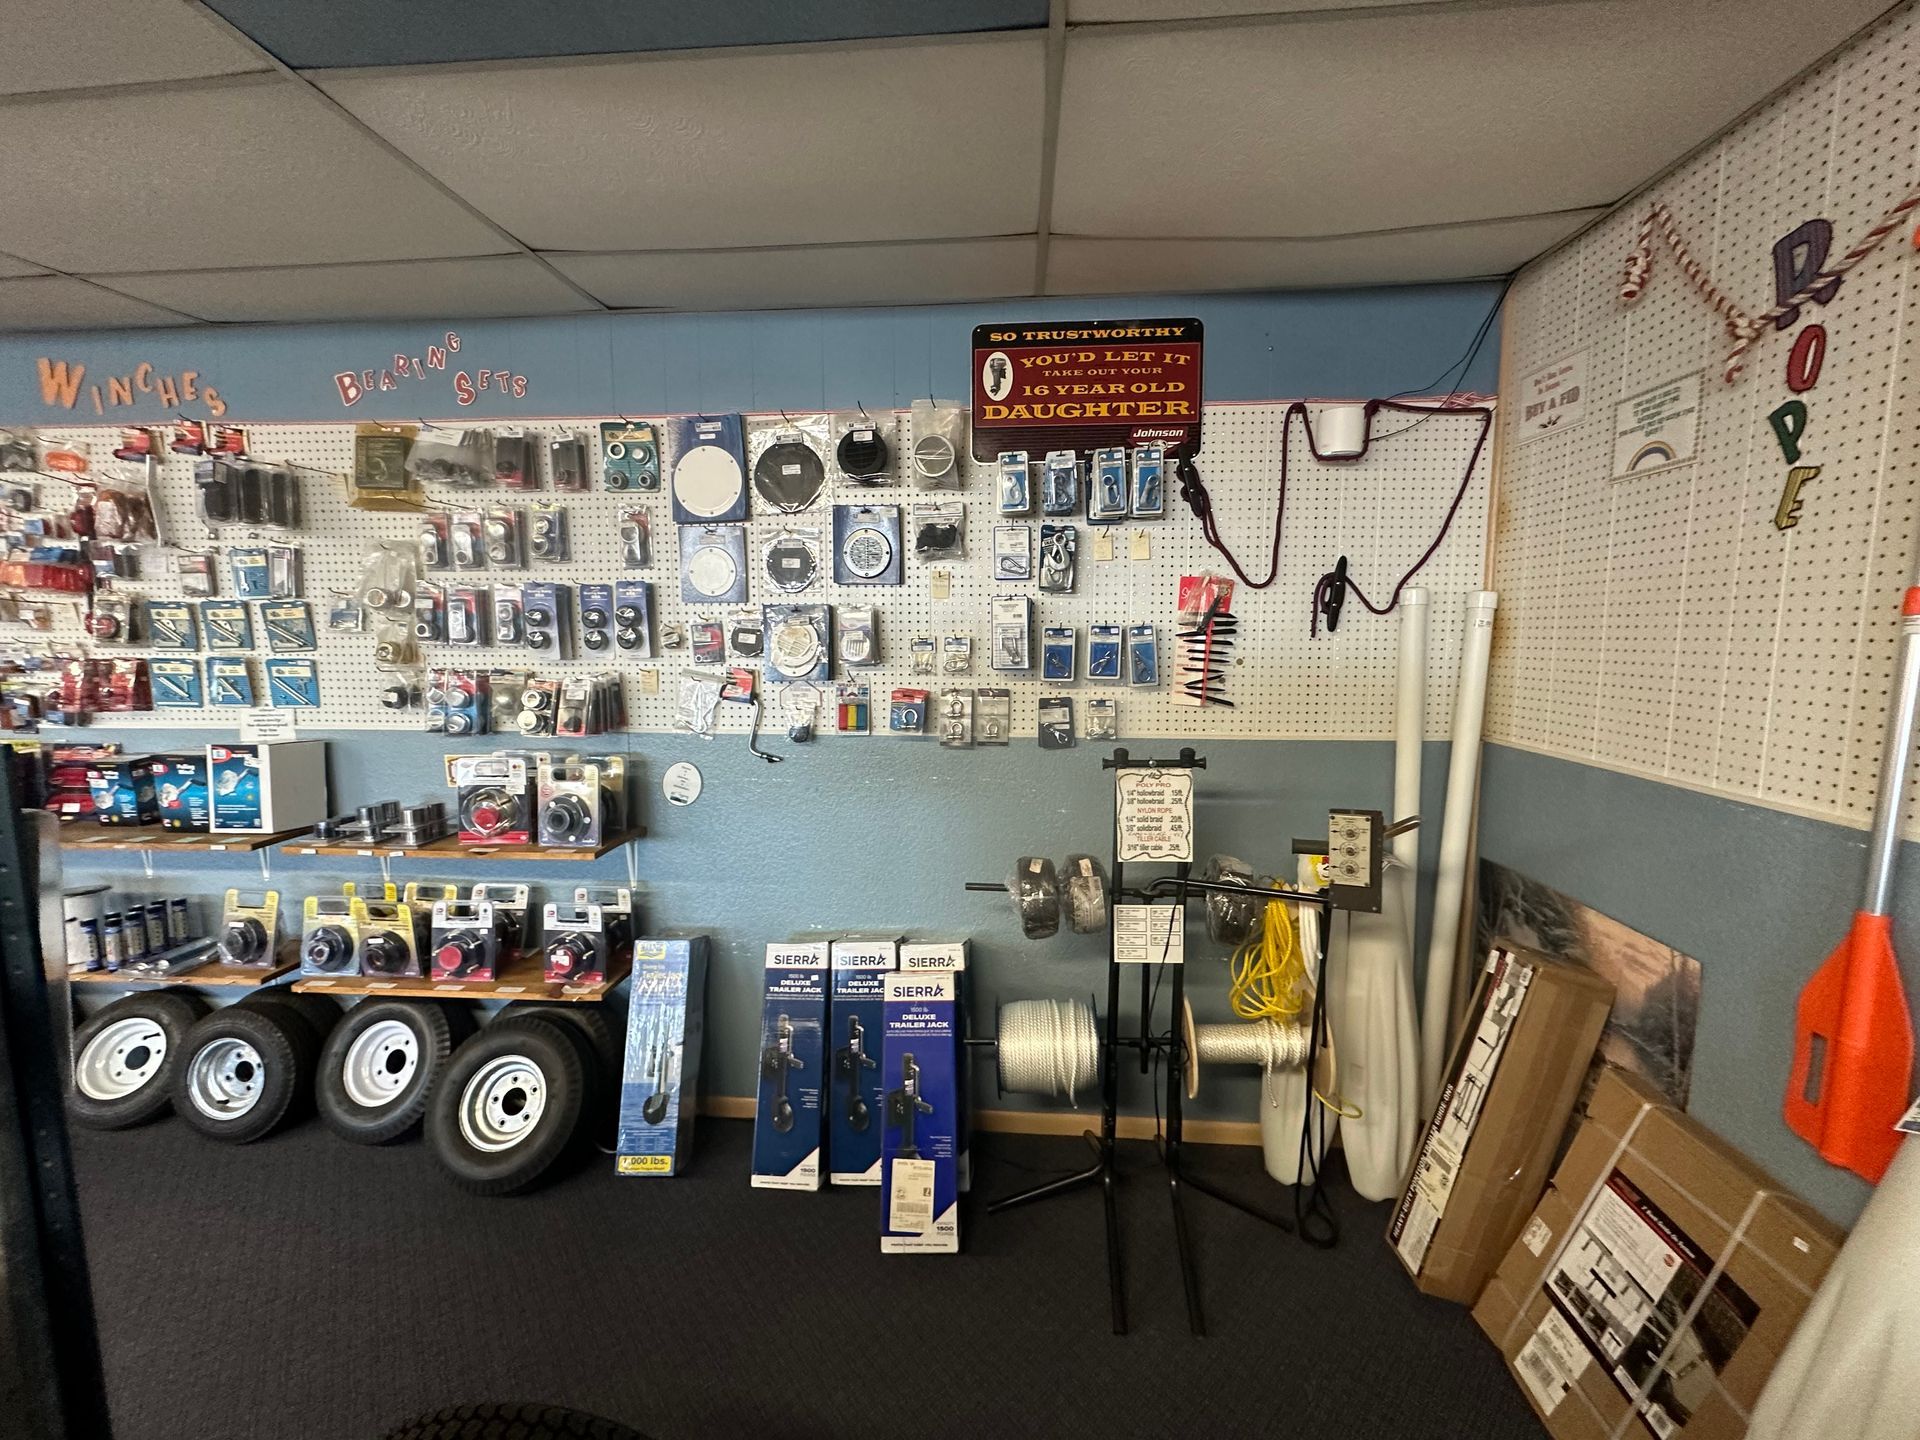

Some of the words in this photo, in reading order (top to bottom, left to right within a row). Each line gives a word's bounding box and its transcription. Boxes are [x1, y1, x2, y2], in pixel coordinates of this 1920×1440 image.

[990, 332, 1017, 342] SO
[1023, 327, 1185, 341] TRUSTWORTHY
[1020, 351, 1096, 369] YOU'D
[1104, 351, 1156, 362] LET
[1163, 353, 1191, 366] IT
[335, 332, 461, 406] BEARING
[1042, 369, 1084, 377] TAKE
[1087, 368, 1118, 376] OUT
[1121, 367, 1163, 375] YOUR
[1767, 219, 1842, 530] ROPE
[37, 357, 227, 416] WINCHES
[454, 371, 528, 406] SETS
[1023, 385, 1049, 396] 16
[1055, 384, 1129, 396] YEAR
[1130, 382, 1185, 394] OLD
[982, 400, 1195, 420] DAUGHTER.
[1132, 428, 1184, 438] Johnson
[774, 953, 820, 965] SIERRA
[840, 953, 887, 965] SIERRA
[908, 954, 955, 968] SIERRA
[893, 984, 944, 997] SIERRA
[650, 1157, 668, 1165] lbs.
